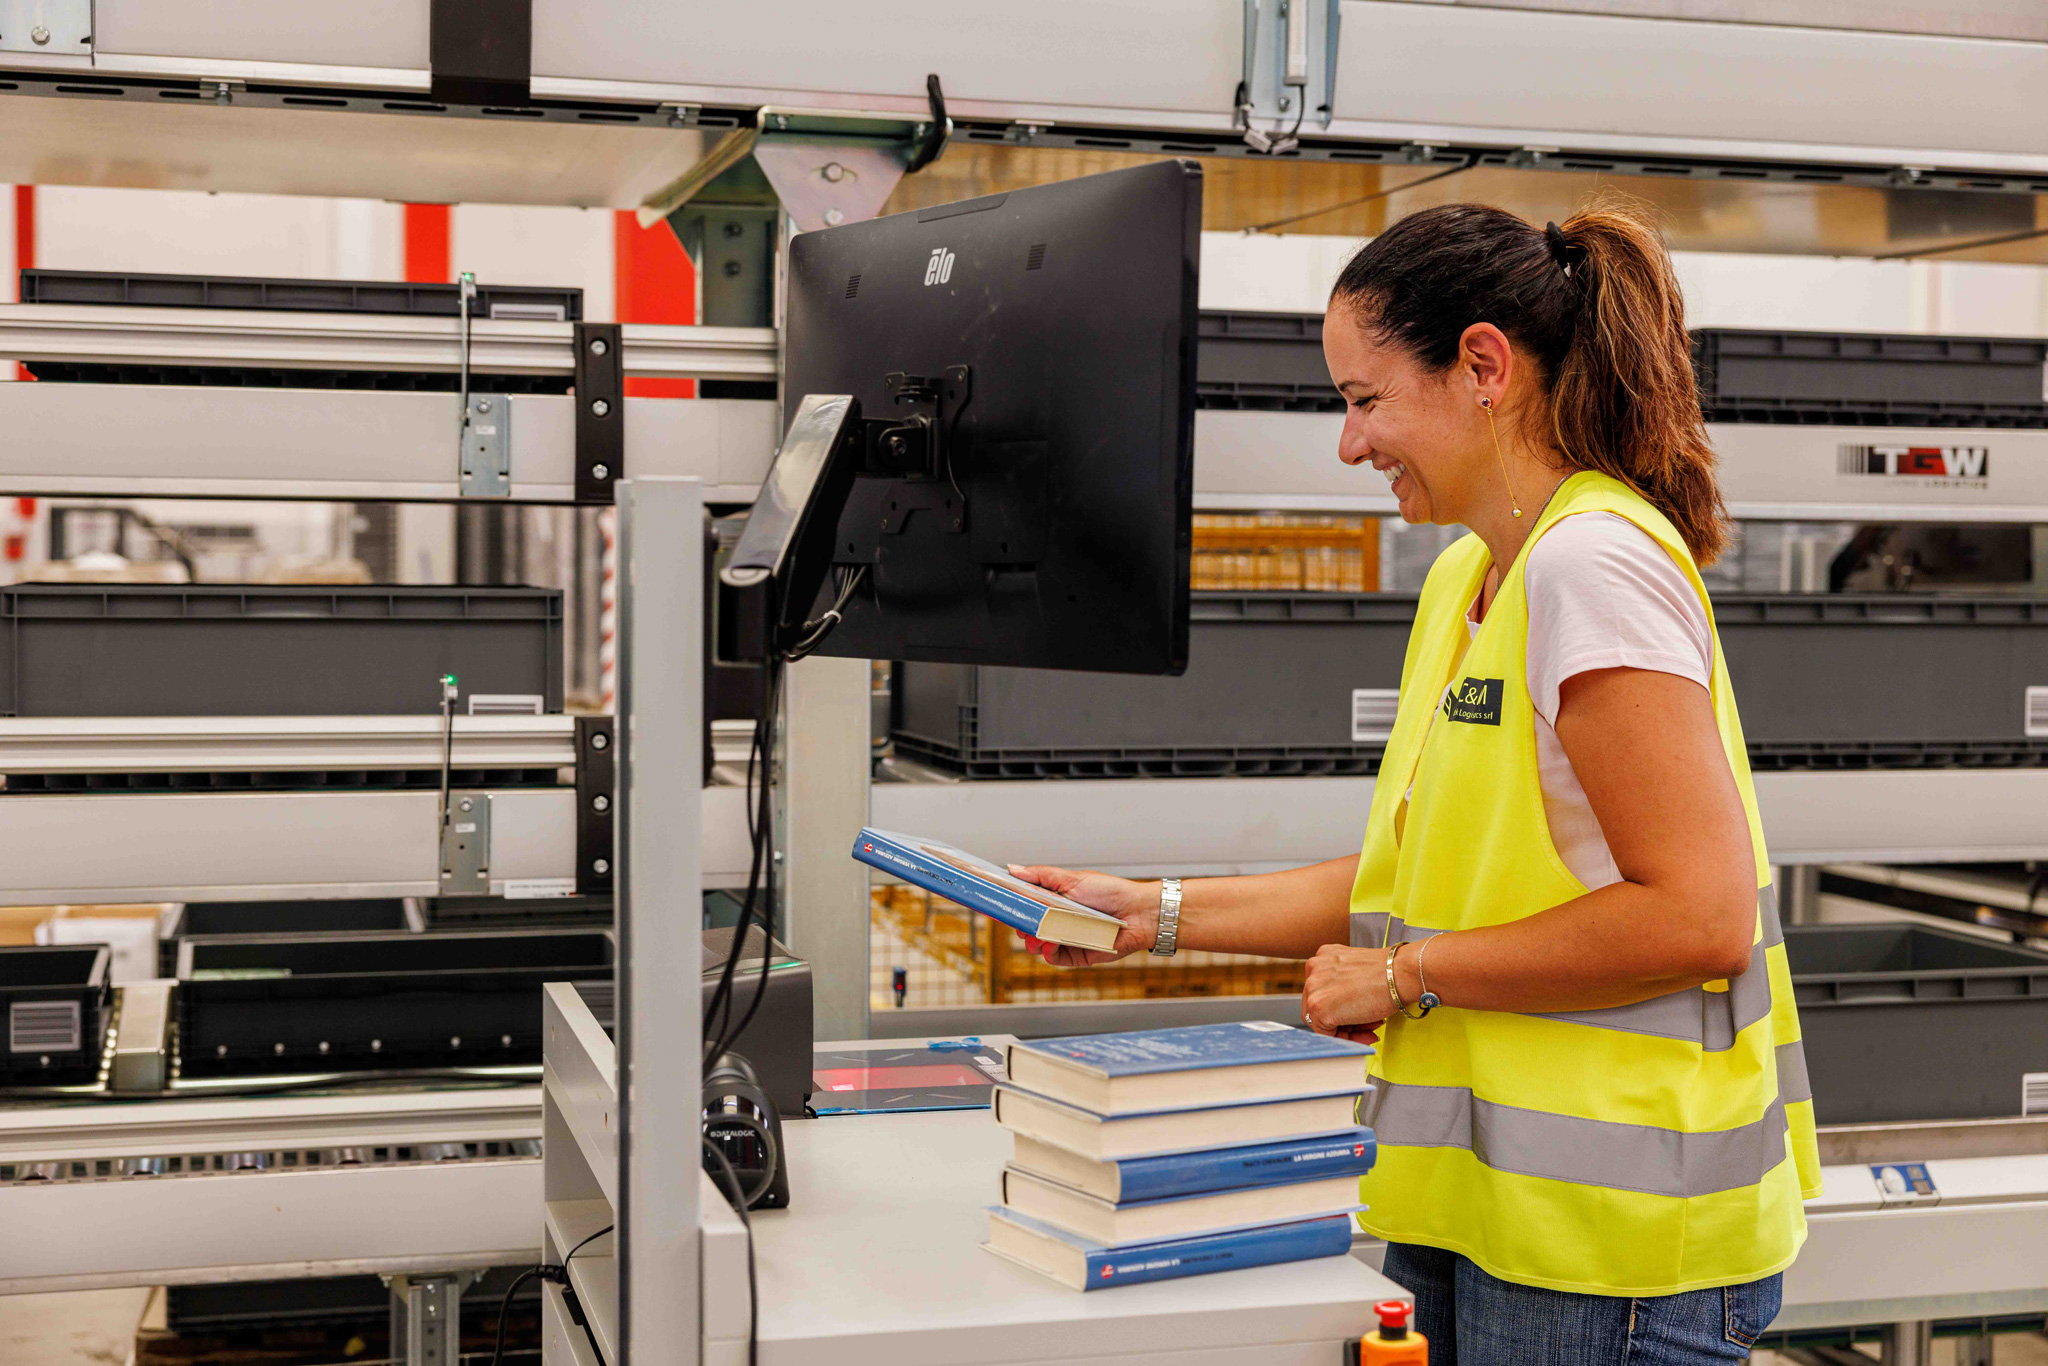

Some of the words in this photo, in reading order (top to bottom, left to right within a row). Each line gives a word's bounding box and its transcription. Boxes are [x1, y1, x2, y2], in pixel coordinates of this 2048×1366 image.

[1873, 447, 1986, 477] TGW
[1483, 711, 1494, 720] srl
[875, 848, 894, 861] AZZURRA
[893, 855, 910, 868] VERGINE
[716, 1130, 755, 1138] DATALOGIC
[1293, 1155, 1302, 1163] LA
[1302, 1151, 1326, 1162] VERGINE
[1326, 1148, 1351, 1159] AZZURRA
